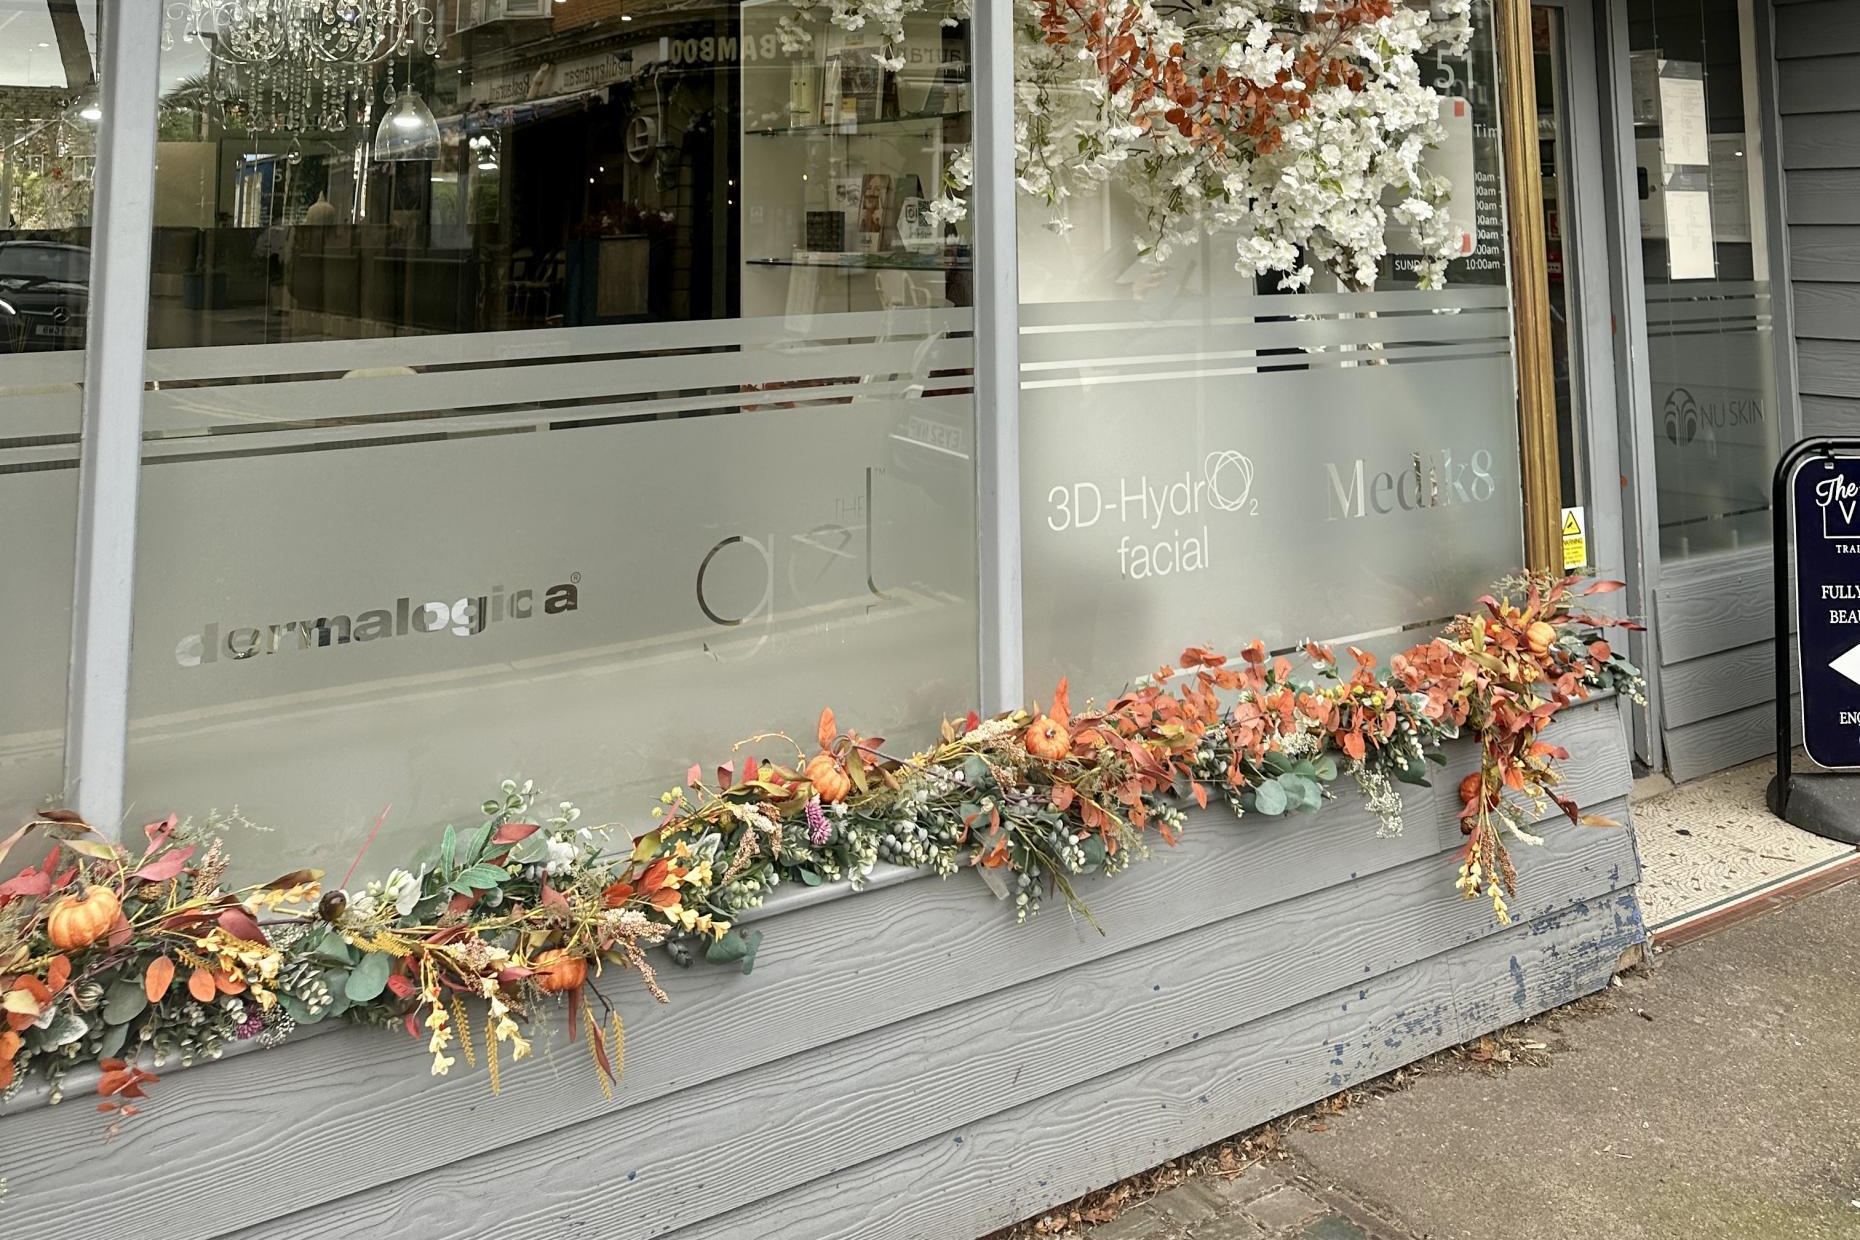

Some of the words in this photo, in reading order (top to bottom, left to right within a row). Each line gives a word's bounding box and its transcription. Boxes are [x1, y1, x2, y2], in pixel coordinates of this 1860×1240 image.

[1395, 259, 1420, 271] SUND
[1466, 259, 1500, 270] 10:00am
[1701, 403, 1725, 429] NU
[1729, 399, 1765, 426] SKIN
[1324, 447, 1497, 522] Medik8
[1816, 473, 1859, 507] The
[1116, 525, 1210, 581] facial
